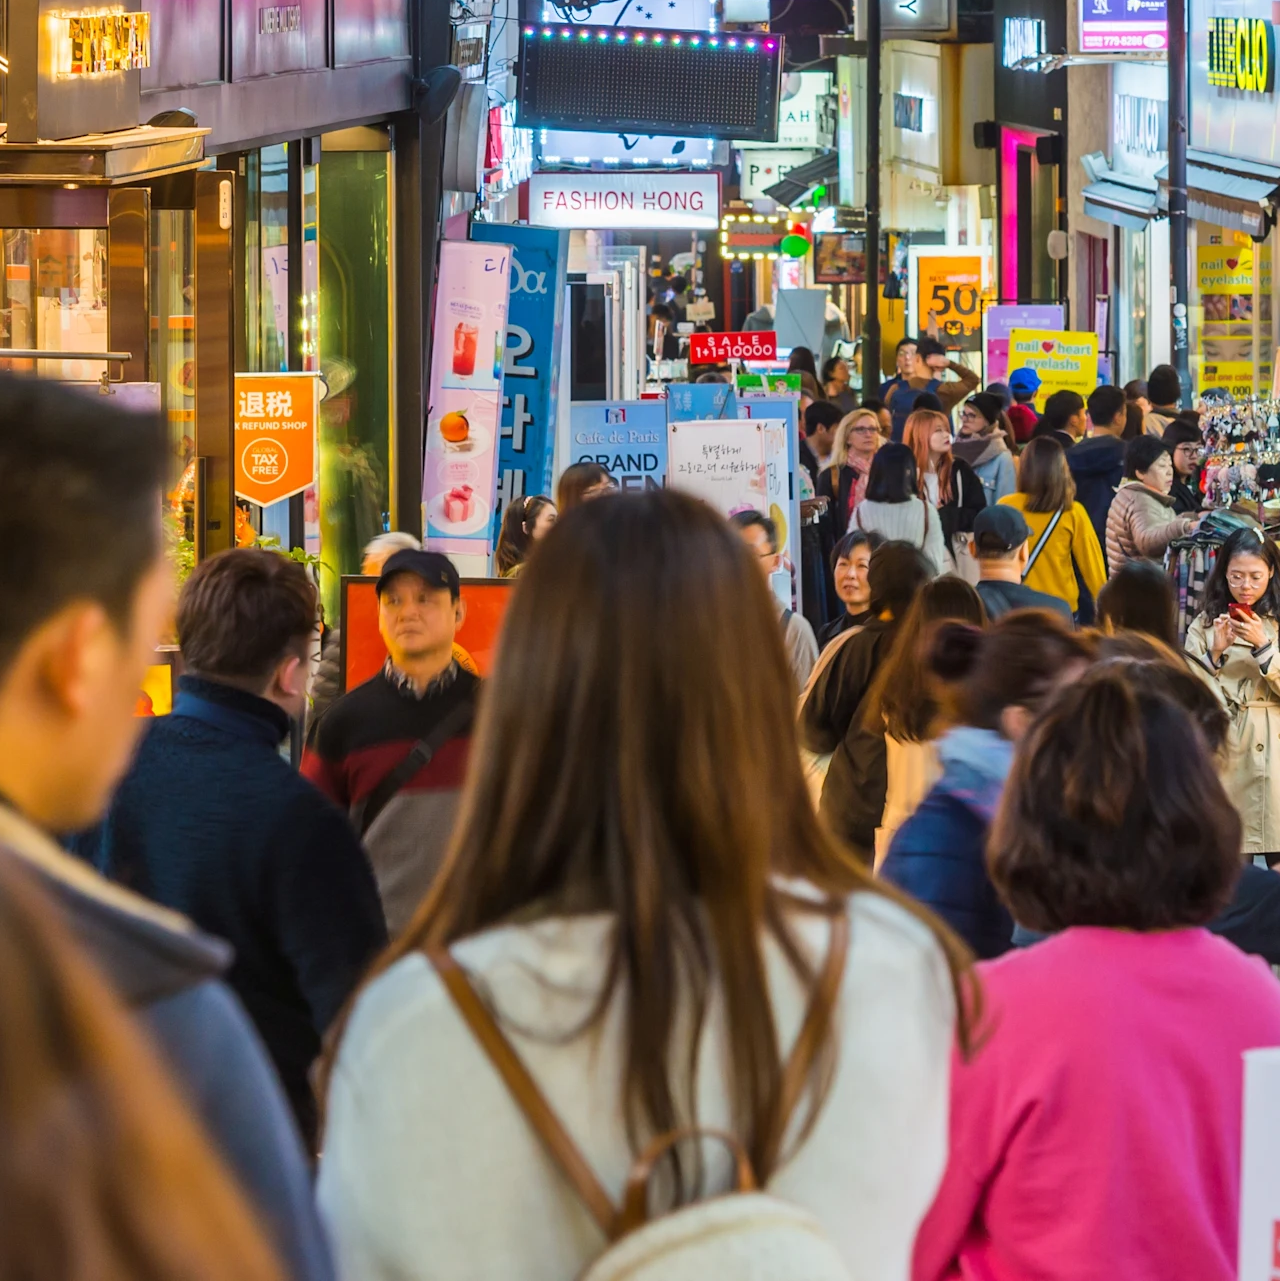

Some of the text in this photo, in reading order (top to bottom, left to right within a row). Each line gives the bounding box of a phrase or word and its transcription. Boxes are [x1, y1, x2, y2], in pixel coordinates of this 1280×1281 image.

[543, 190, 704, 213] FASHION HONG
[1200, 258, 1224, 270] nail
[707, 335, 760, 347] SALE
[1015, 339, 1092, 356] nail heart
[695, 343, 773, 359] 1+1=10000
[239, 390, 293, 418] 退税
[242, 421, 280, 431] REFUND
[281, 421, 307, 430] SHOP
[575, 428, 660, 446] Cafe de Paris
[251, 453, 278, 465] TAX
[251, 465, 278, 475] FREE
